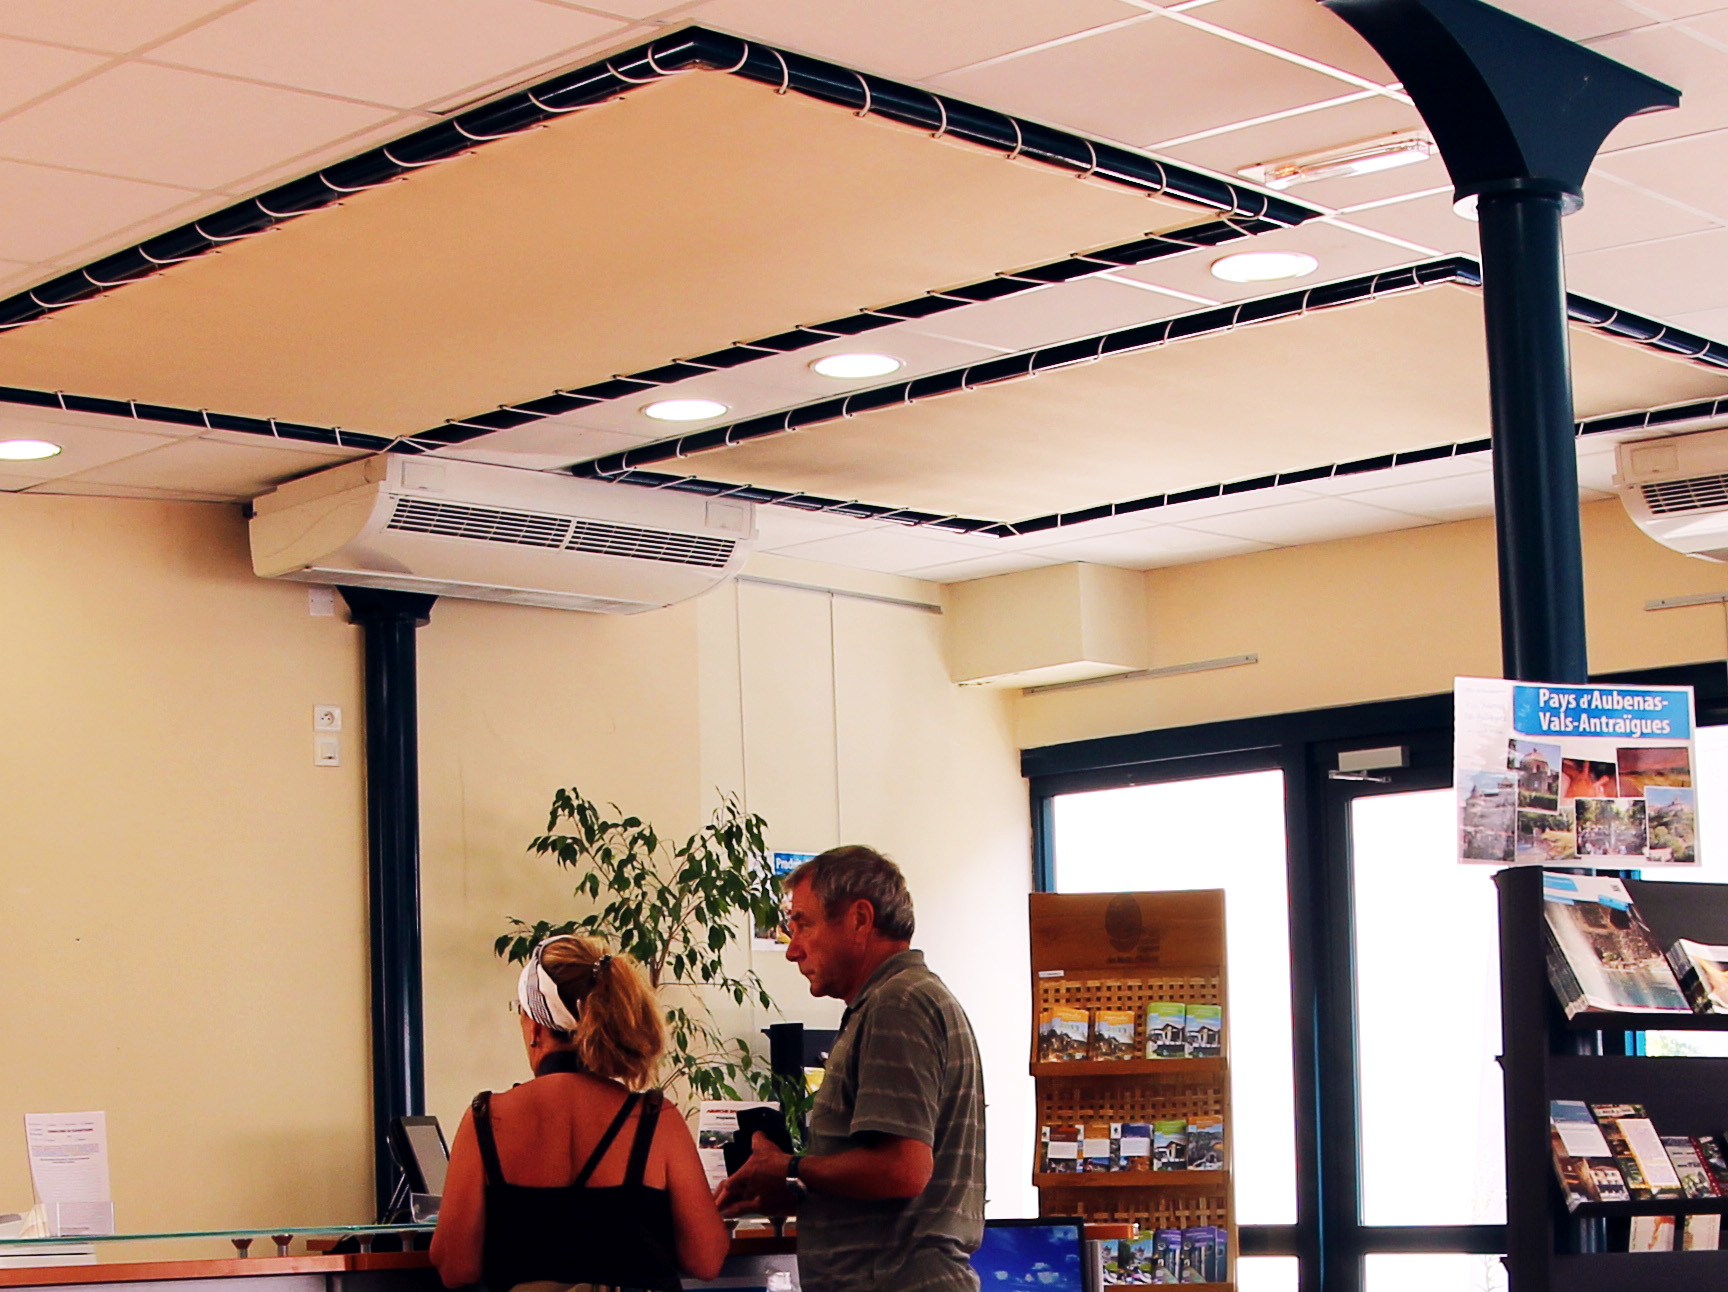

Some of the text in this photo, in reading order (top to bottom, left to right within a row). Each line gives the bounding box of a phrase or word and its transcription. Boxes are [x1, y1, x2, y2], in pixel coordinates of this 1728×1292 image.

[1539, 688, 1669, 713] Pays d'Aubenas-
[1538, 711, 1671, 738] Vals-Antraïgues
